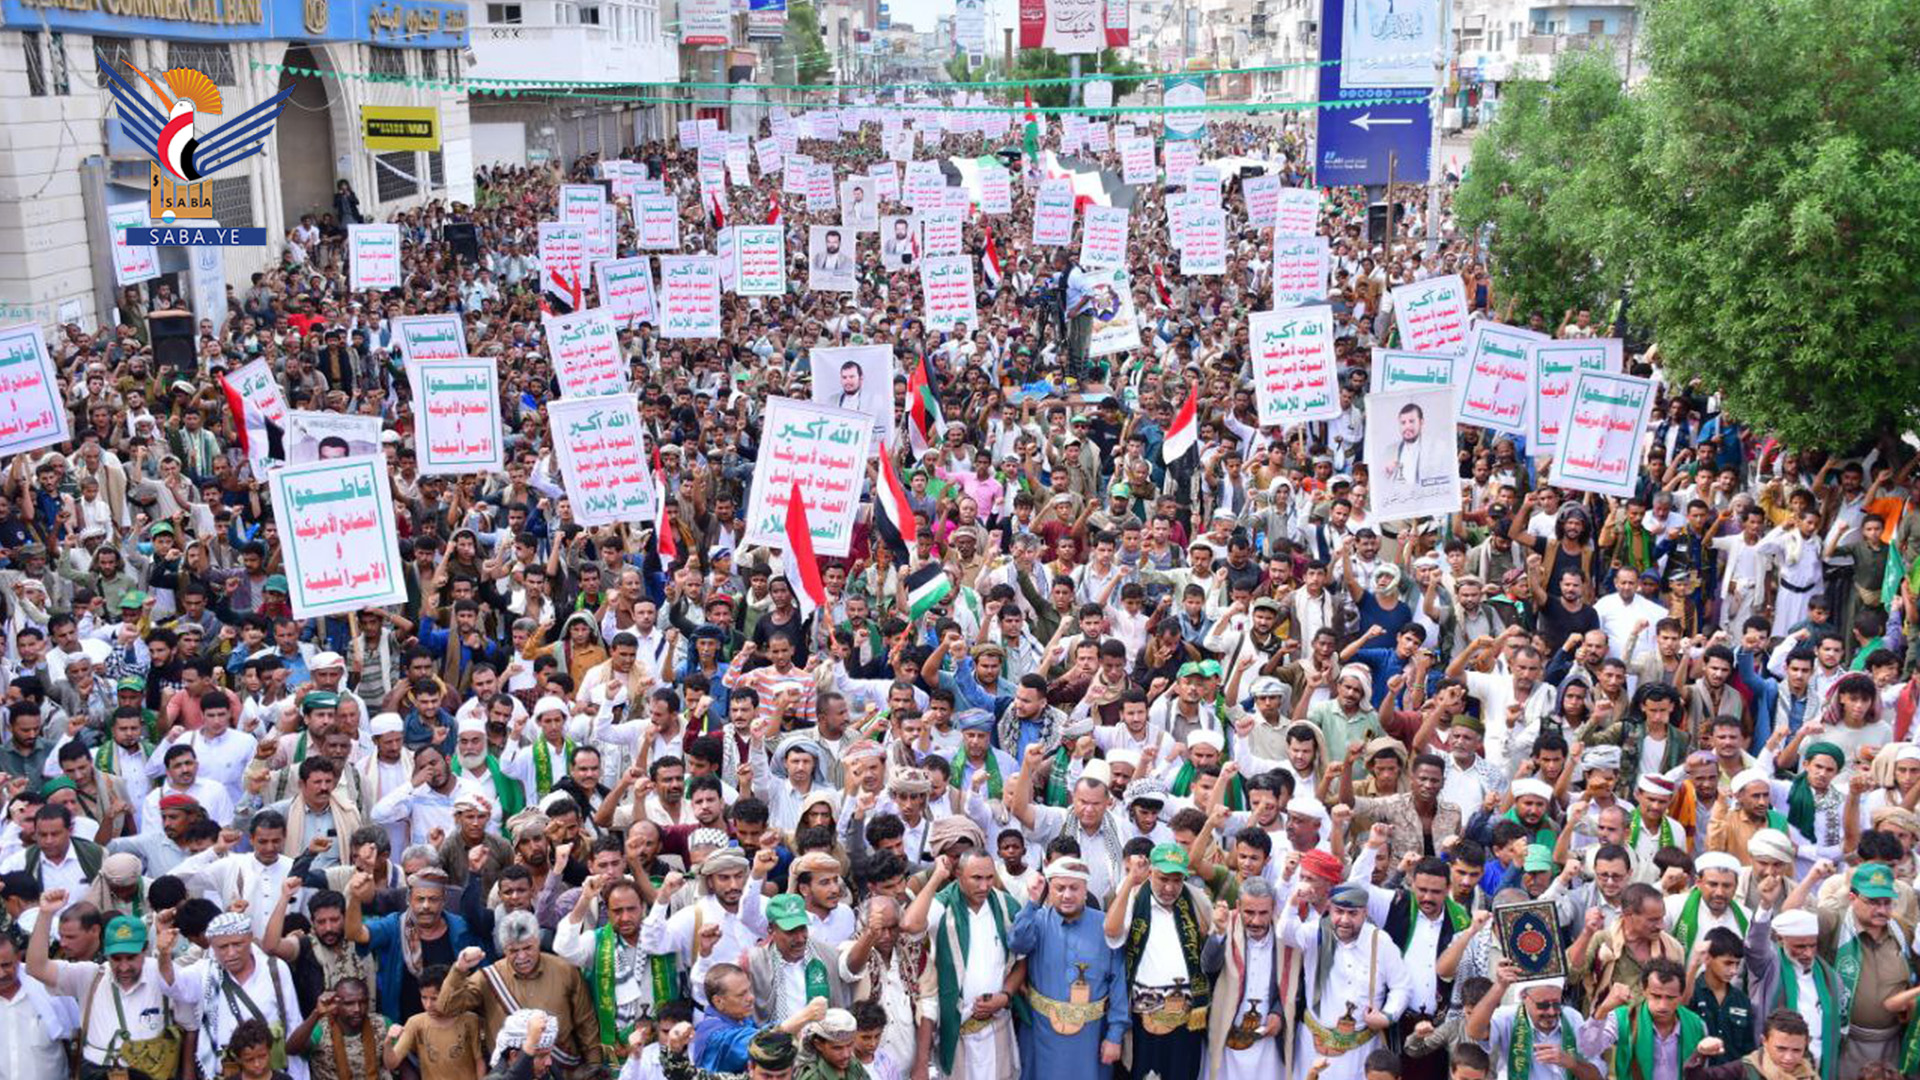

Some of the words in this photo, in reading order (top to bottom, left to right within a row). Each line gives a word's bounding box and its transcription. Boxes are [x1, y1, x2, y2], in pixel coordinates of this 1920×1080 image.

[225, 0, 264, 24] BANK
[1407, 289, 1436, 311] أكبر
[1437, 287, 1455, 301] الله
[559, 321, 588, 346] أكبر
[590, 322, 611, 336] الله
[1262, 319, 1298, 344] أكبر
[1301, 320, 1323, 335] الله
[426, 374, 488, 396] قاطعوا
[1387, 363, 1448, 386] قاطعوا
[1581, 382, 1643, 408] قاطعوا
[569, 409, 604, 438] أكبر
[608, 411, 631, 429] الله
[776, 415, 830, 443] أكبر
[828, 423, 860, 445] الله
[431, 438, 491, 456] الإسرائيلية
[773, 445, 817, 465] لأمريكا
[819, 453, 855, 470] الموت
[288, 475, 373, 514] قاطعوا
[816, 475, 851, 493] الموت
[584, 491, 618, 515] للإسلام
[622, 486, 650, 508] النصر
[820, 497, 848, 513] اللعنة
[295, 512, 339, 542] الأمريكية
[340, 509, 377, 536] البضائع
[336, 541, 343, 560] و
[305, 562, 387, 594] الإسرائيلية
